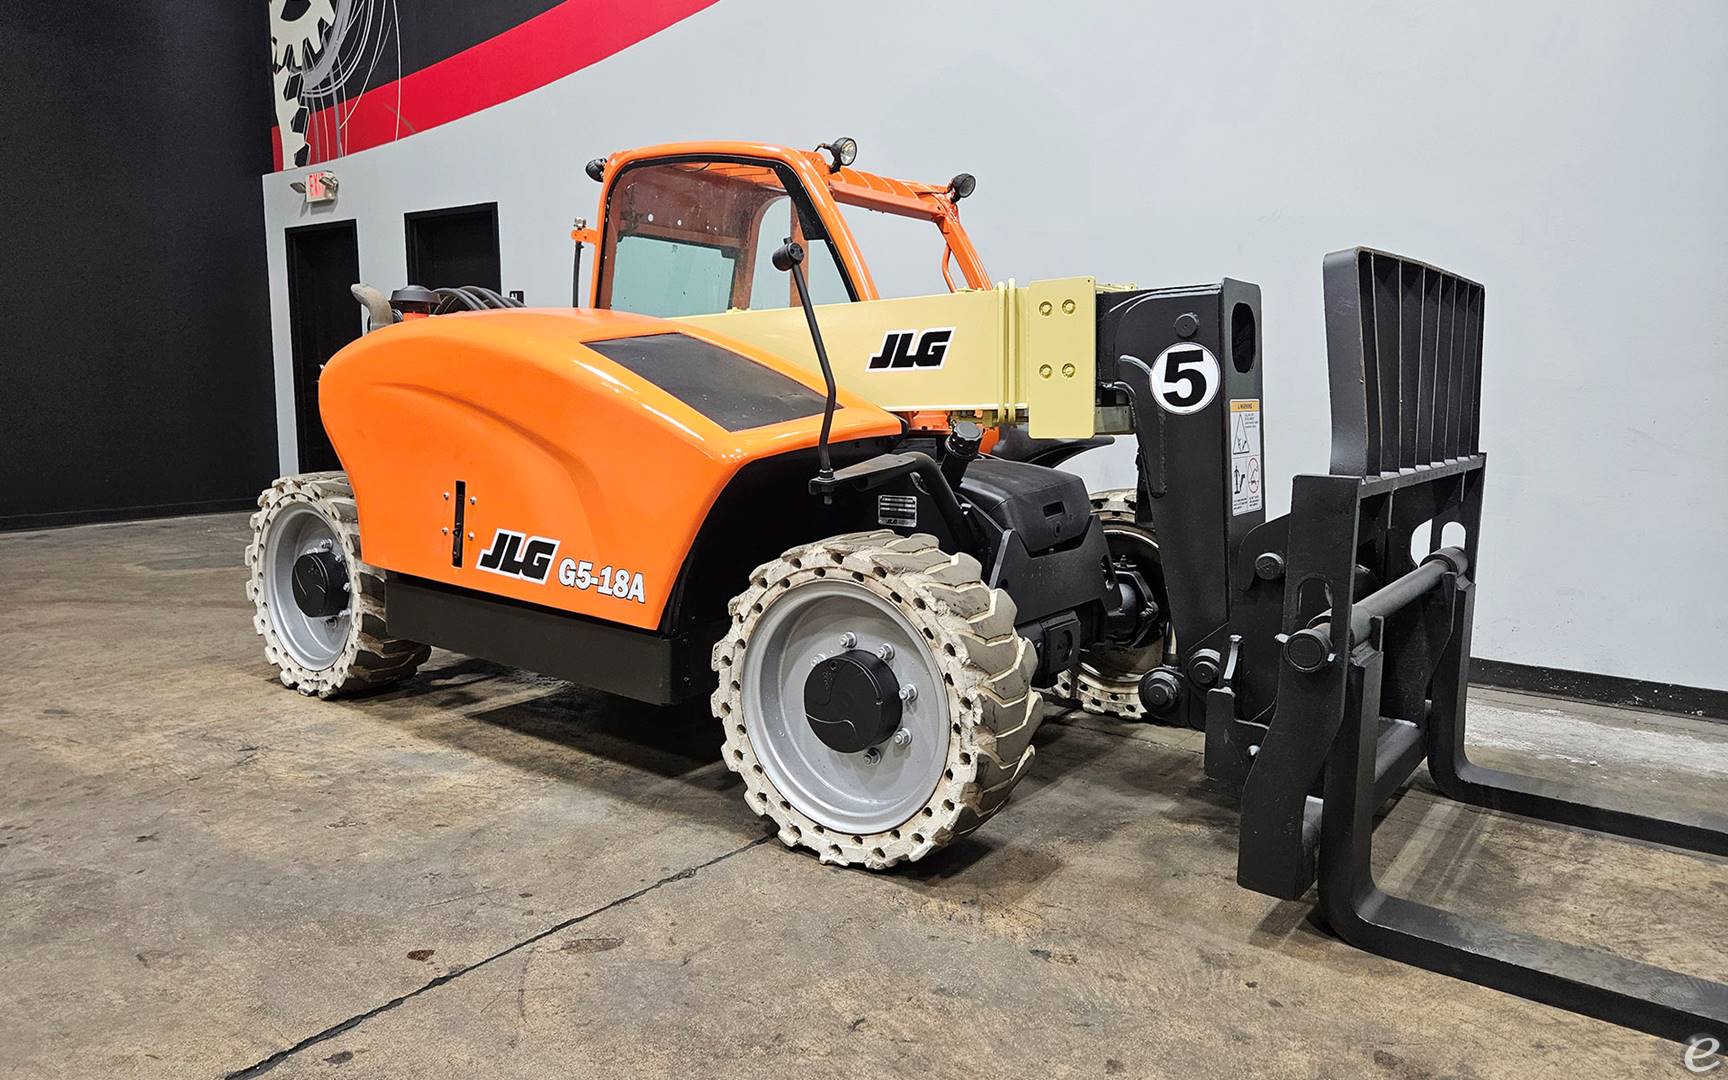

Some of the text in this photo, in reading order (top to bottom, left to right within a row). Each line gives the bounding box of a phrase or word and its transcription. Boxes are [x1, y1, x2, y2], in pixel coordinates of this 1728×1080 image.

[869, 330, 952, 369] JLG
[1163, 349, 1207, 407] 5
[479, 532, 646, 604] JLG G5-18A
